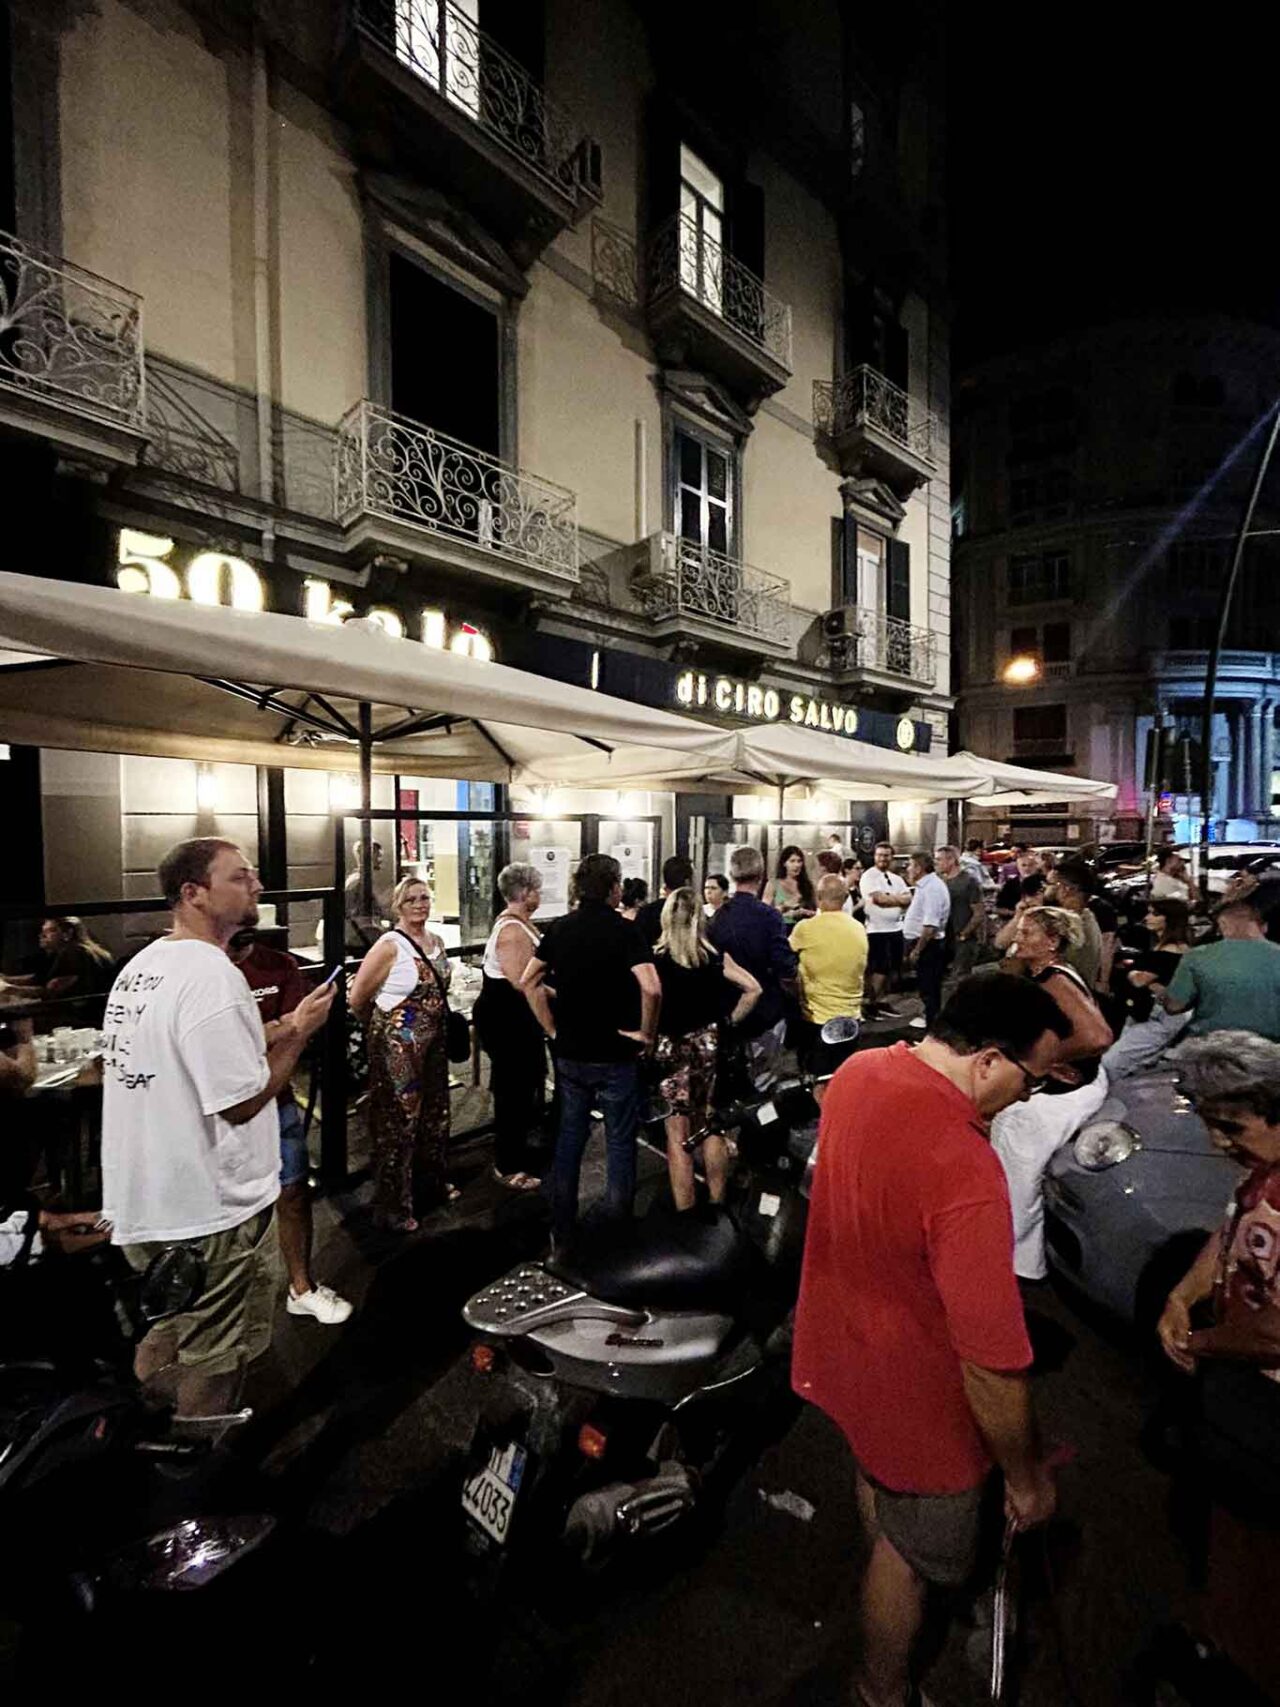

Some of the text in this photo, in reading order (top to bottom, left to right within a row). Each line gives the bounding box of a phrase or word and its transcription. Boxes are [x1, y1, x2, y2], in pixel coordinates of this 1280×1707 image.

[117, 528, 264, 613] 50
[677, 671, 707, 705] di
[714, 678, 780, 719] CIRO
[789, 695, 858, 734] SALVO
